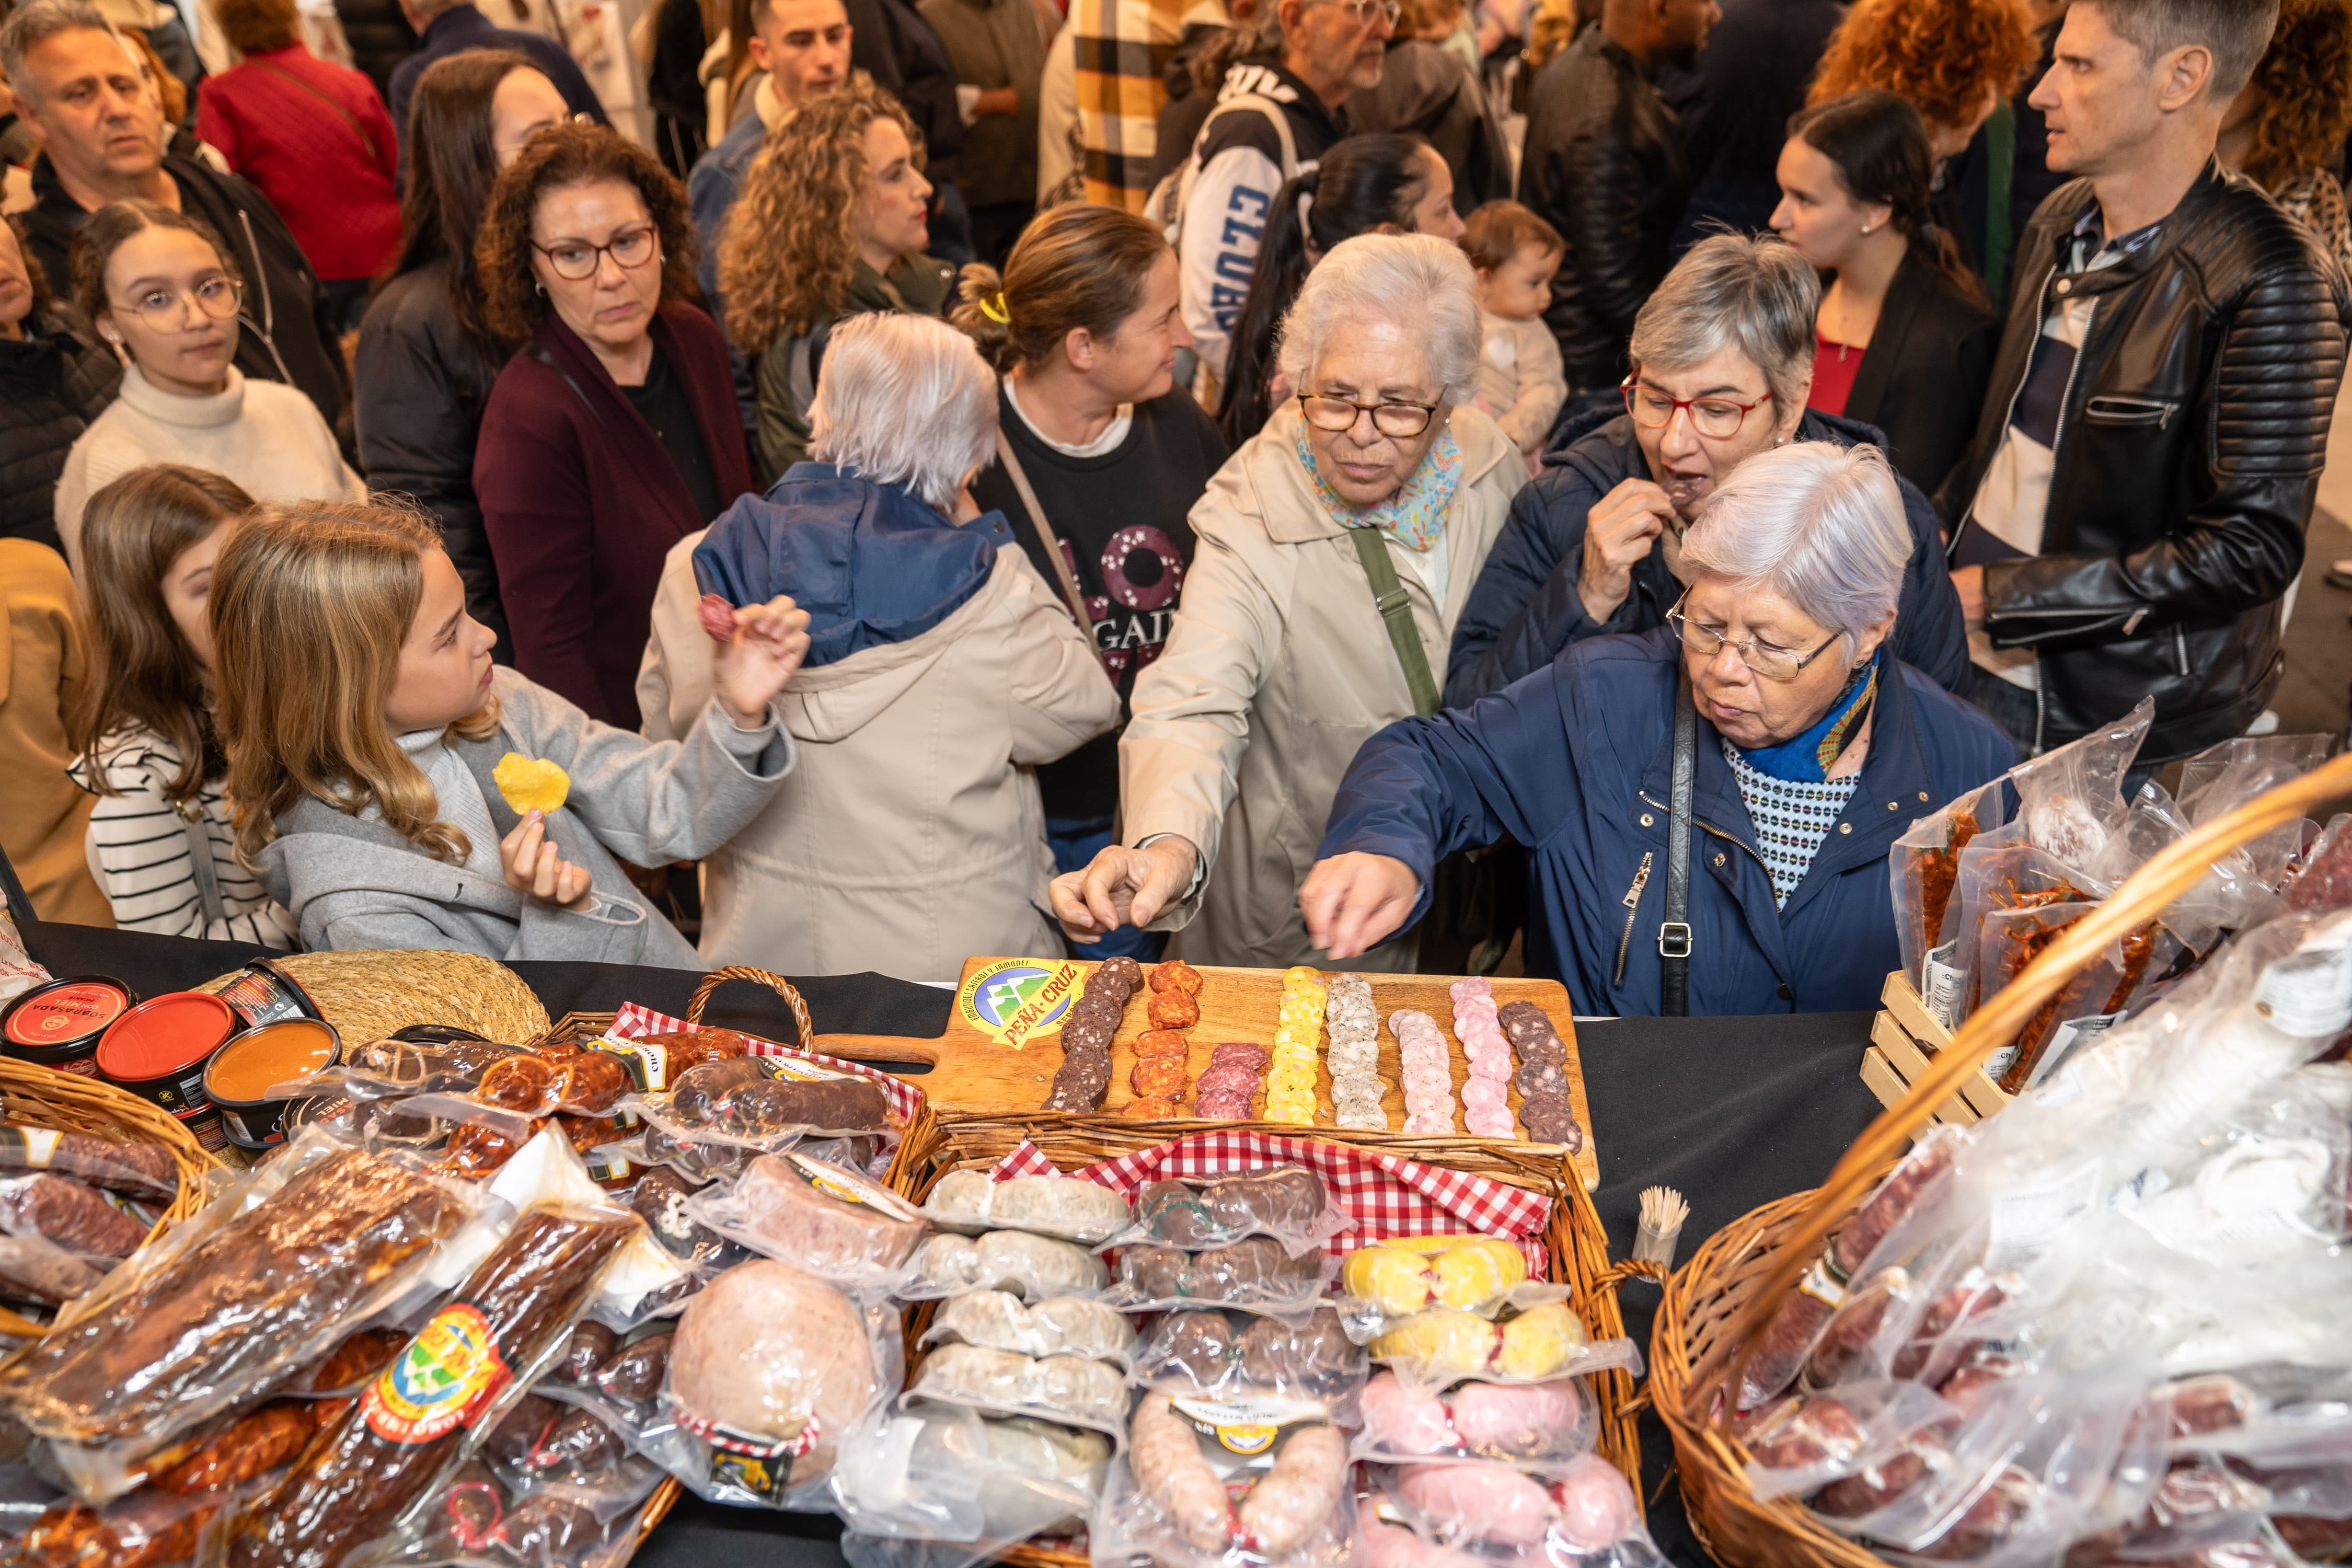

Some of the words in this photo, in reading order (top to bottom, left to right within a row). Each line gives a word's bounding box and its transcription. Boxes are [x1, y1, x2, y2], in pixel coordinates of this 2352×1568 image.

[995, 960, 1029, 972] JAMONES
[966, 972, 988, 991] CASEROS
[33, 1005, 106, 1019] SOBRASADA
[54, 999, 80, 1008] MIEL
[963, 992, 979, 1021] EMBUTIDOS
[1004, 1003, 1045, 1046] PEÑA
[1042, 964, 1077, 1003] CRUZ
[316, 1097, 349, 1116] MIEL
